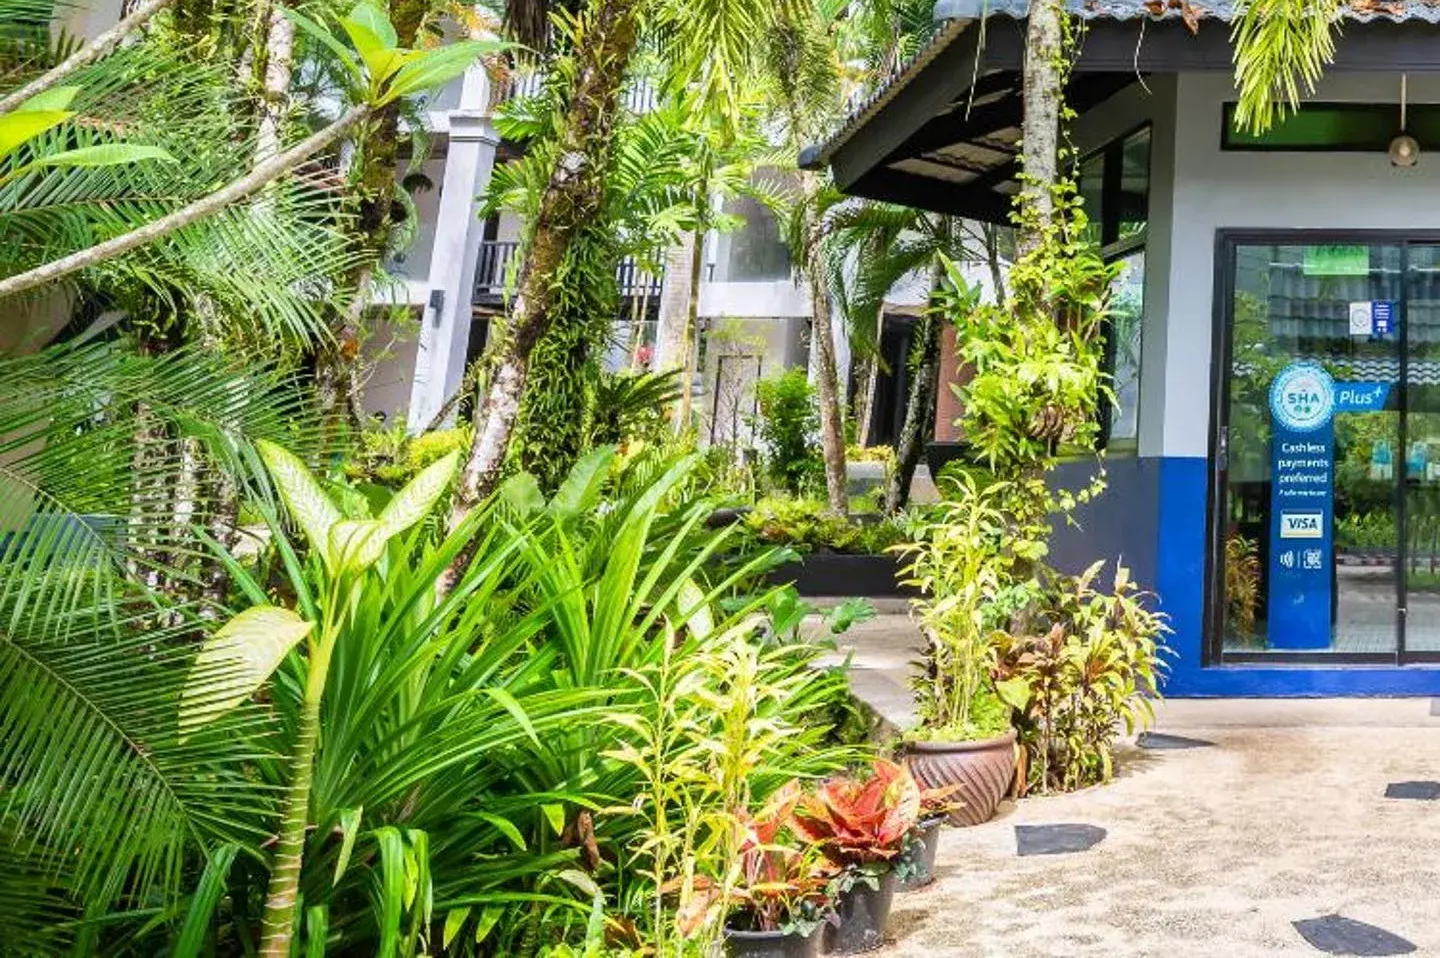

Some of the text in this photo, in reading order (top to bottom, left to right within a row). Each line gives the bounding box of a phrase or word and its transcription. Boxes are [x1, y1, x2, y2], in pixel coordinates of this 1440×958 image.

[1287, 392, 1320, 404] SHA
[1281, 442, 1325, 453] Cashless
[1278, 458, 1329, 471] payments
[1279, 472, 1327, 484] preferred
[1288, 517, 1317, 529] VISA
